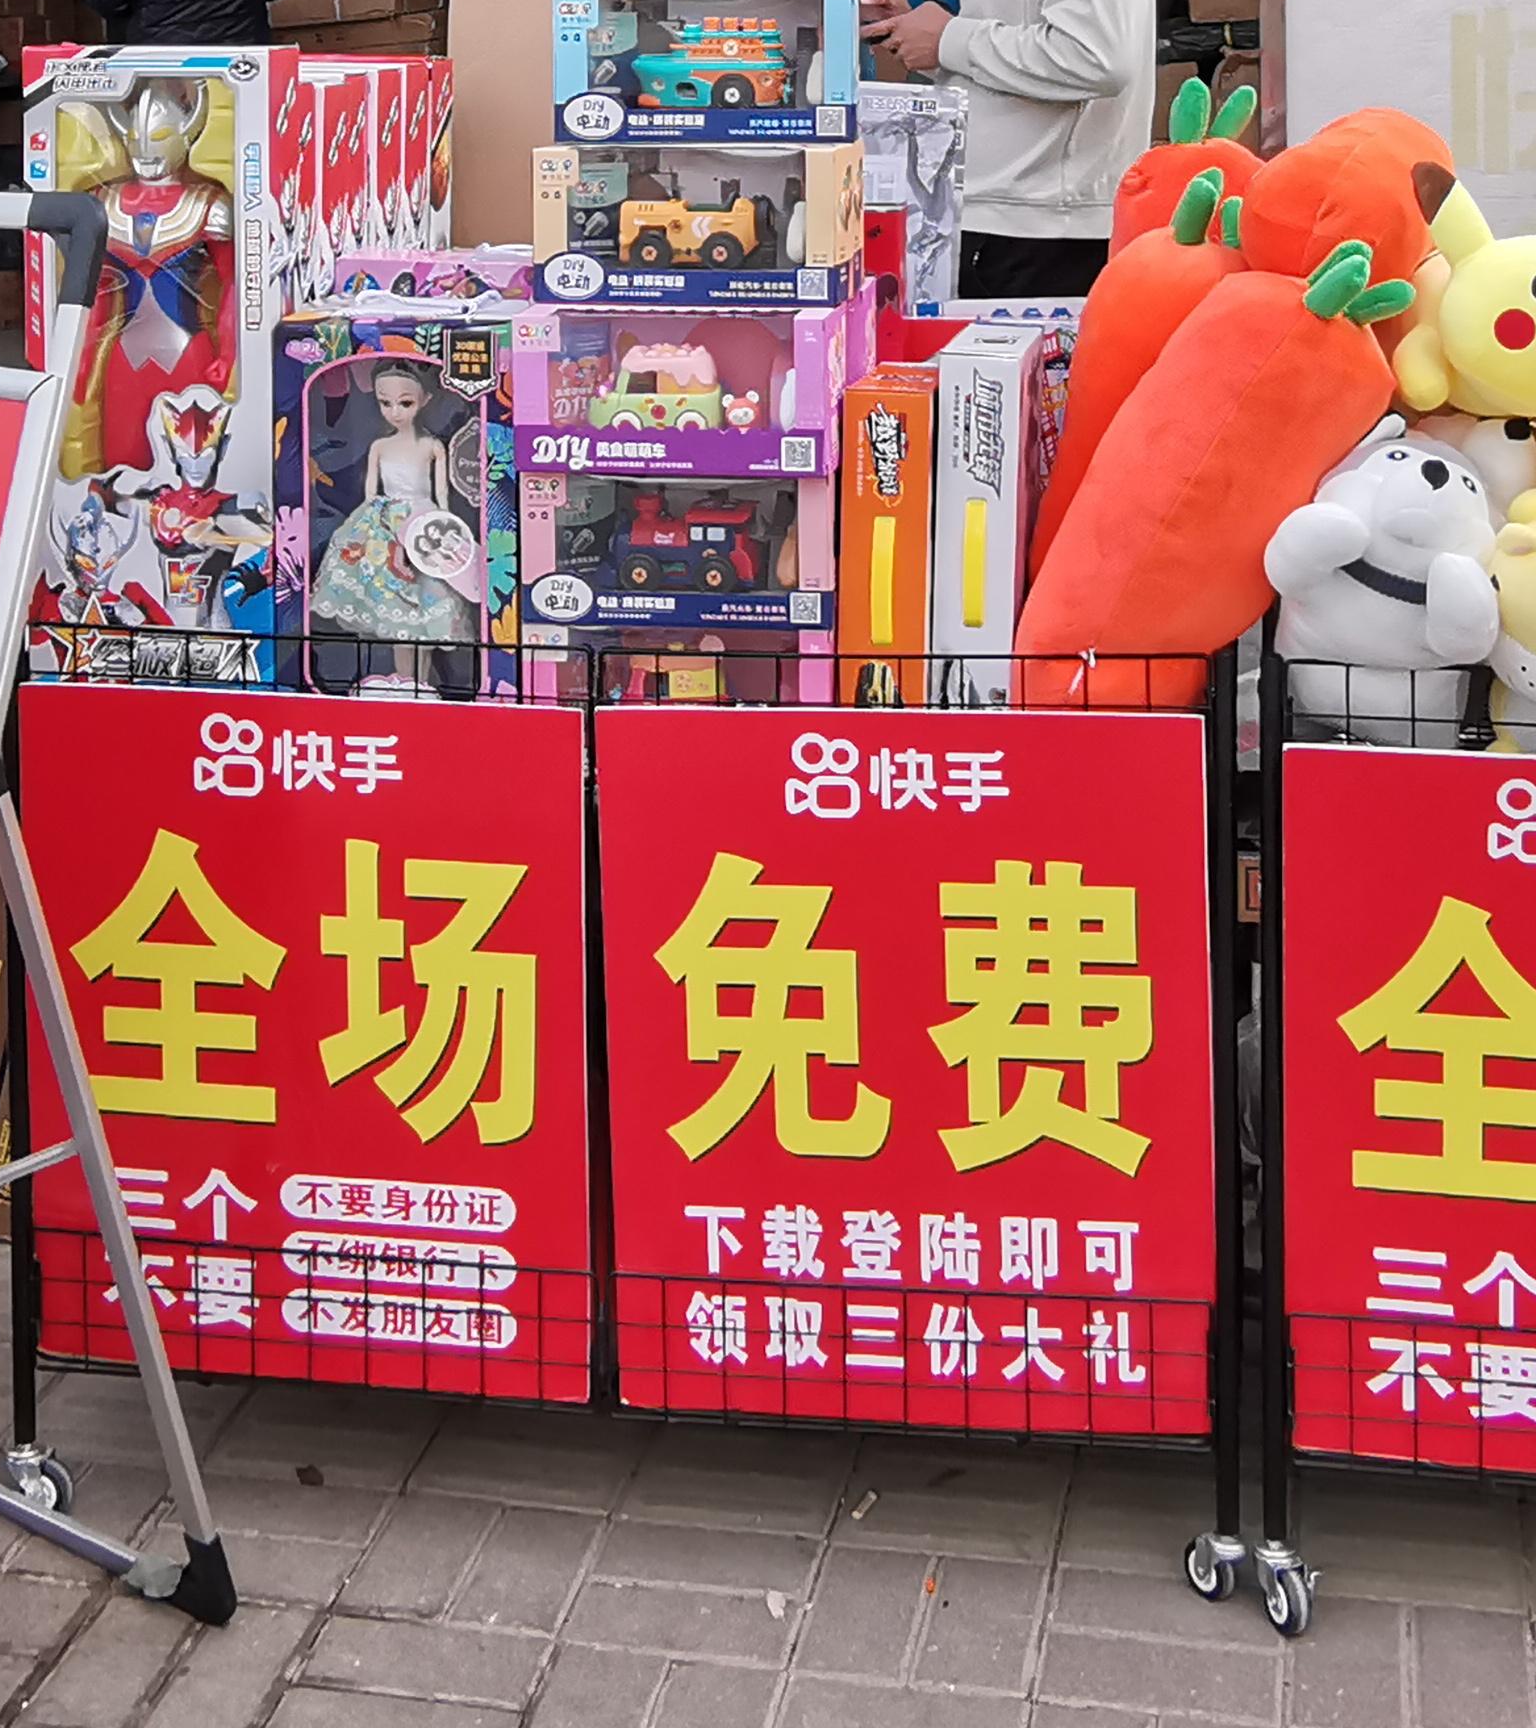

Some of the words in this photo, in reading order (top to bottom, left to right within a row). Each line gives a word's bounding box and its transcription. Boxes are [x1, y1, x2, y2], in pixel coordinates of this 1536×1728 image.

[531, 435, 595, 470] DIY
[272, 729, 402, 794] 快手
[869, 746, 1009, 813] 快手
[69, 828, 537, 1145] 全场
[654, 851, 1154, 1177] 免费
[114, 1166, 258, 1241] 三个
[296, 1180, 503, 1228] 不要身份证
[296, 1237, 501, 1285] 不绑银行卡
[684, 1203, 1140, 1293] 下载登陆即可
[298, 1296, 503, 1345] 不发朋友圈
[685, 1289, 1147, 1385] 领取三份大礼
